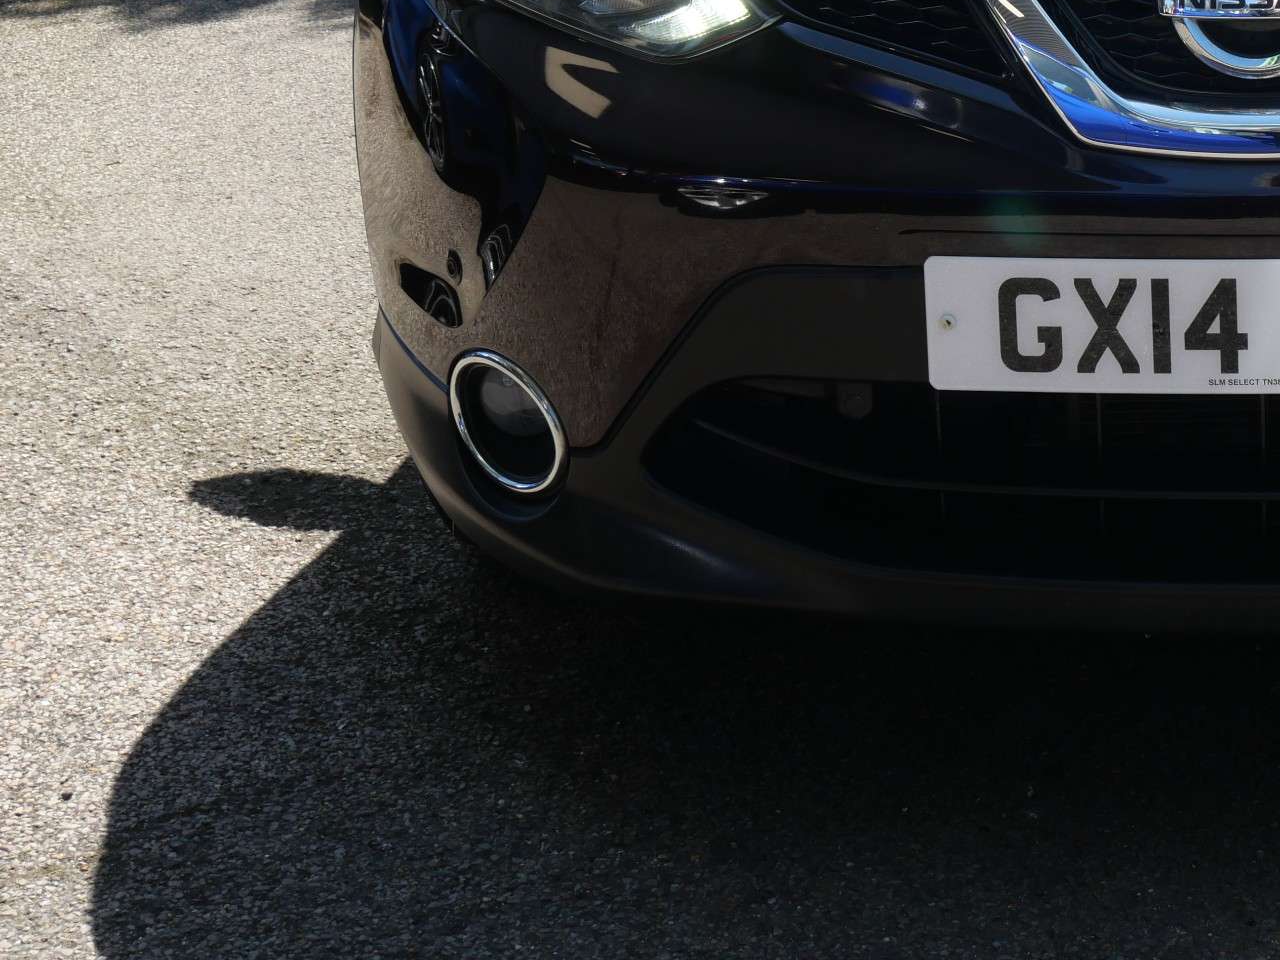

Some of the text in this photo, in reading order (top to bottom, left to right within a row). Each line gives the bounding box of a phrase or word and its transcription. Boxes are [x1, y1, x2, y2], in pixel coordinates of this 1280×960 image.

[998, 277, 1249, 374] GX14
[1208, 378, 1226, 386] SLM
[1228, 378, 1260, 386] SELECT
